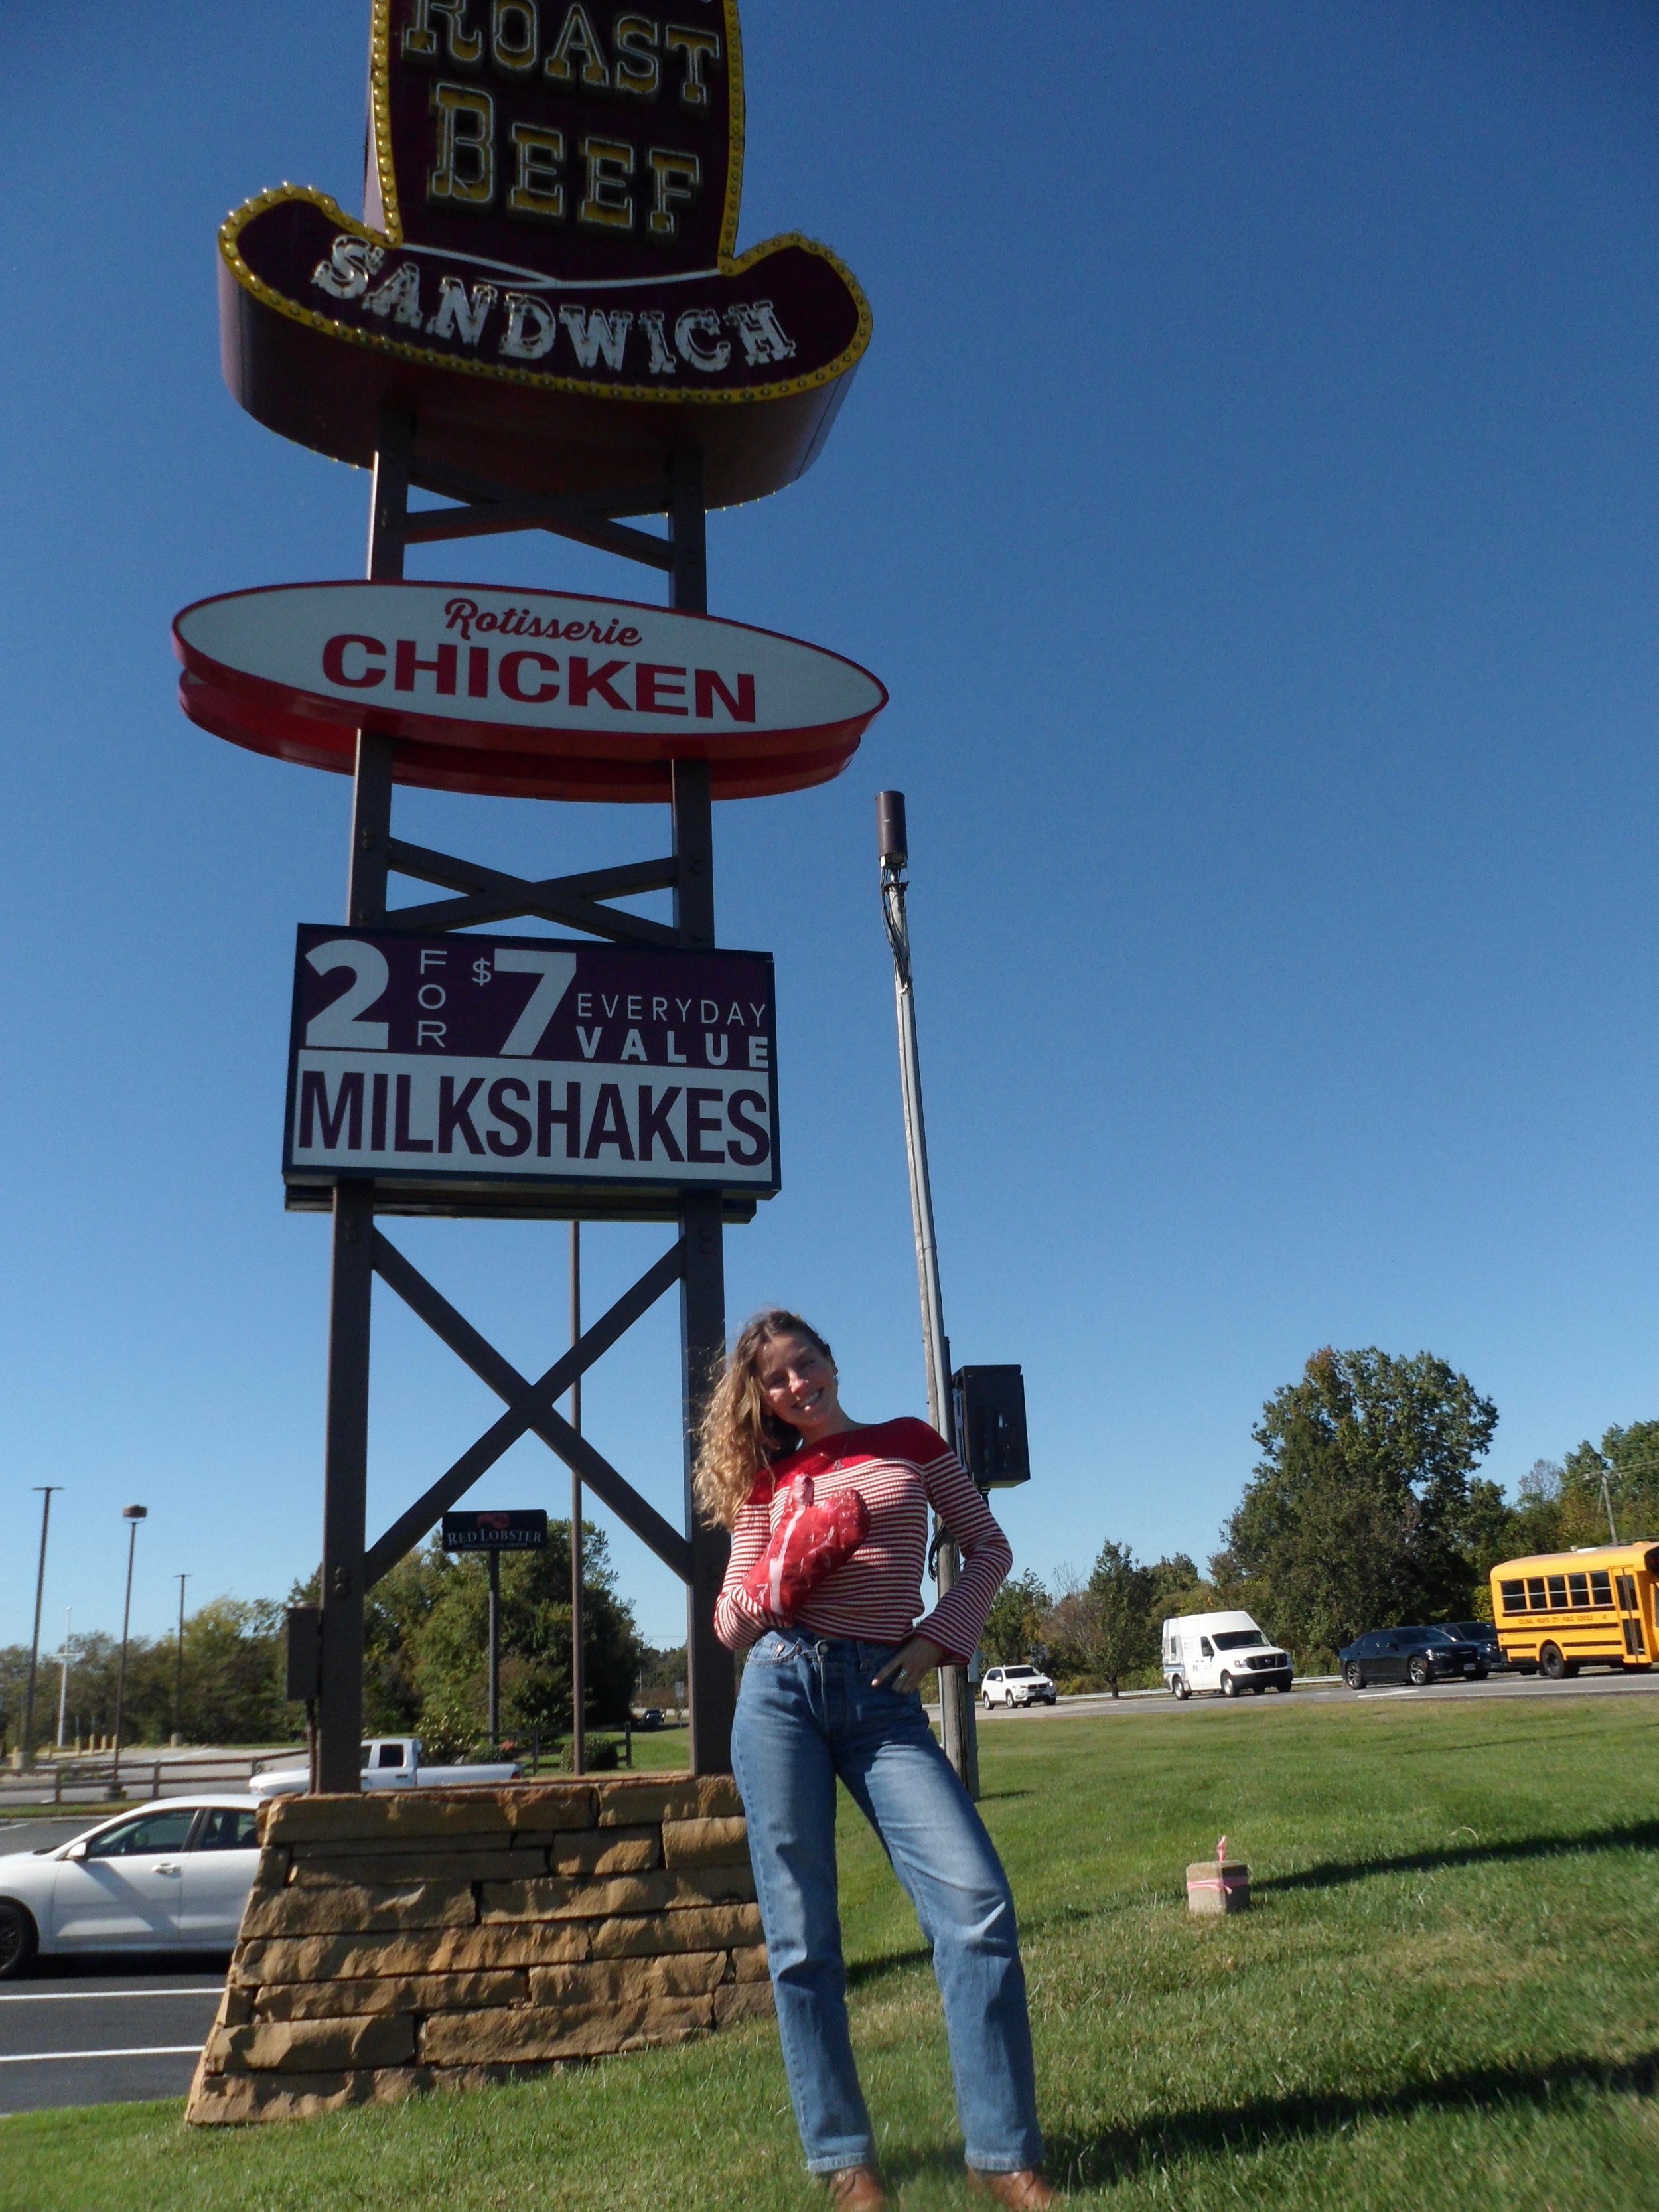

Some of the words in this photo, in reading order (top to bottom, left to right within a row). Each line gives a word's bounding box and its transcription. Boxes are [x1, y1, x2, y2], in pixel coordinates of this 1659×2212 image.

[401, 0, 721, 105] ROAST
[429, 81, 700, 234] BEEF
[311, 234, 797, 374] SANDWICH
[444, 597, 643, 648] Rotisserie
[322, 634, 757, 723] CHICKEN
[305, 938, 389, 1050] 2
[417, 949, 448, 1047] FOR
[472, 948, 577, 1057] $7
[577, 993, 766, 1027] EVERYDAY
[575, 1025, 769, 1068] VALUE
[298, 1070, 770, 1167] MILKSHAKES
[447, 1532, 477, 1546] RED
[480, 1528, 541, 1543] LOBSTER
